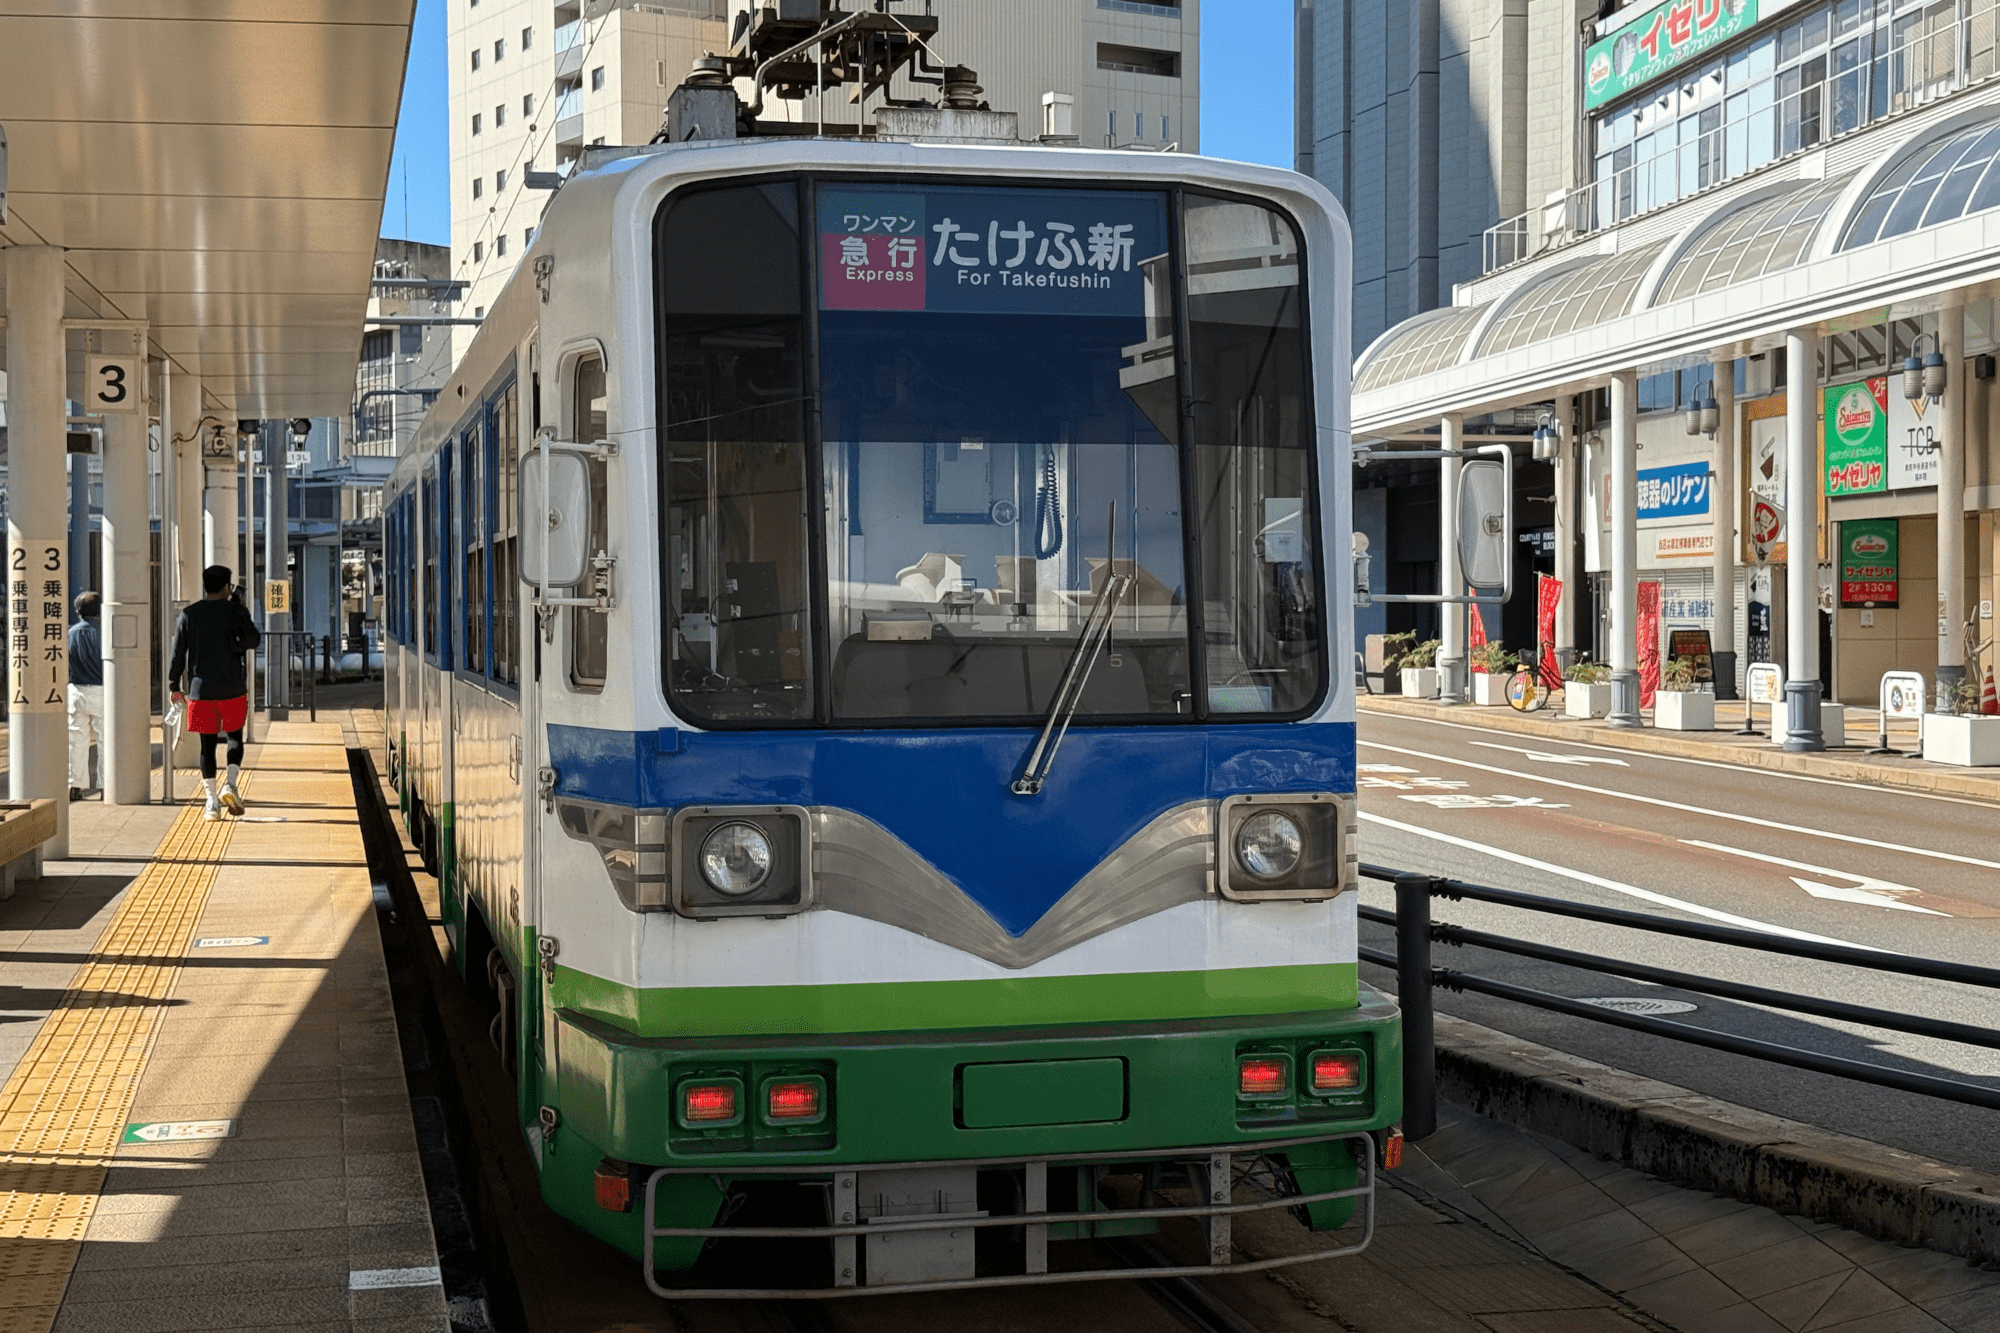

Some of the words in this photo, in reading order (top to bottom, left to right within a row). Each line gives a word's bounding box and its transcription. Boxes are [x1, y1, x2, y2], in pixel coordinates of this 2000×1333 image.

[843, 215, 915, 233] ワンマン
[933, 217, 1135, 272] たけふ新
[846, 267, 914, 283] Express
[957, 270, 990, 286] For
[999, 271, 1111, 289] Takefushin
[97, 364, 127, 403] 3
[1907, 426, 1934, 457] TCB
[1830, 461, 1882, 491] サイゼリヤ
[12, 547, 27, 571] 2
[43, 547, 61, 571] 3
[1845, 566, 1895, 578] サイゼリヤ
[11, 580, 30, 705] 乗車専用ホーム
[42, 580, 63, 705] 乗降用ホーム
[1109, 653, 1123, 668] 5
